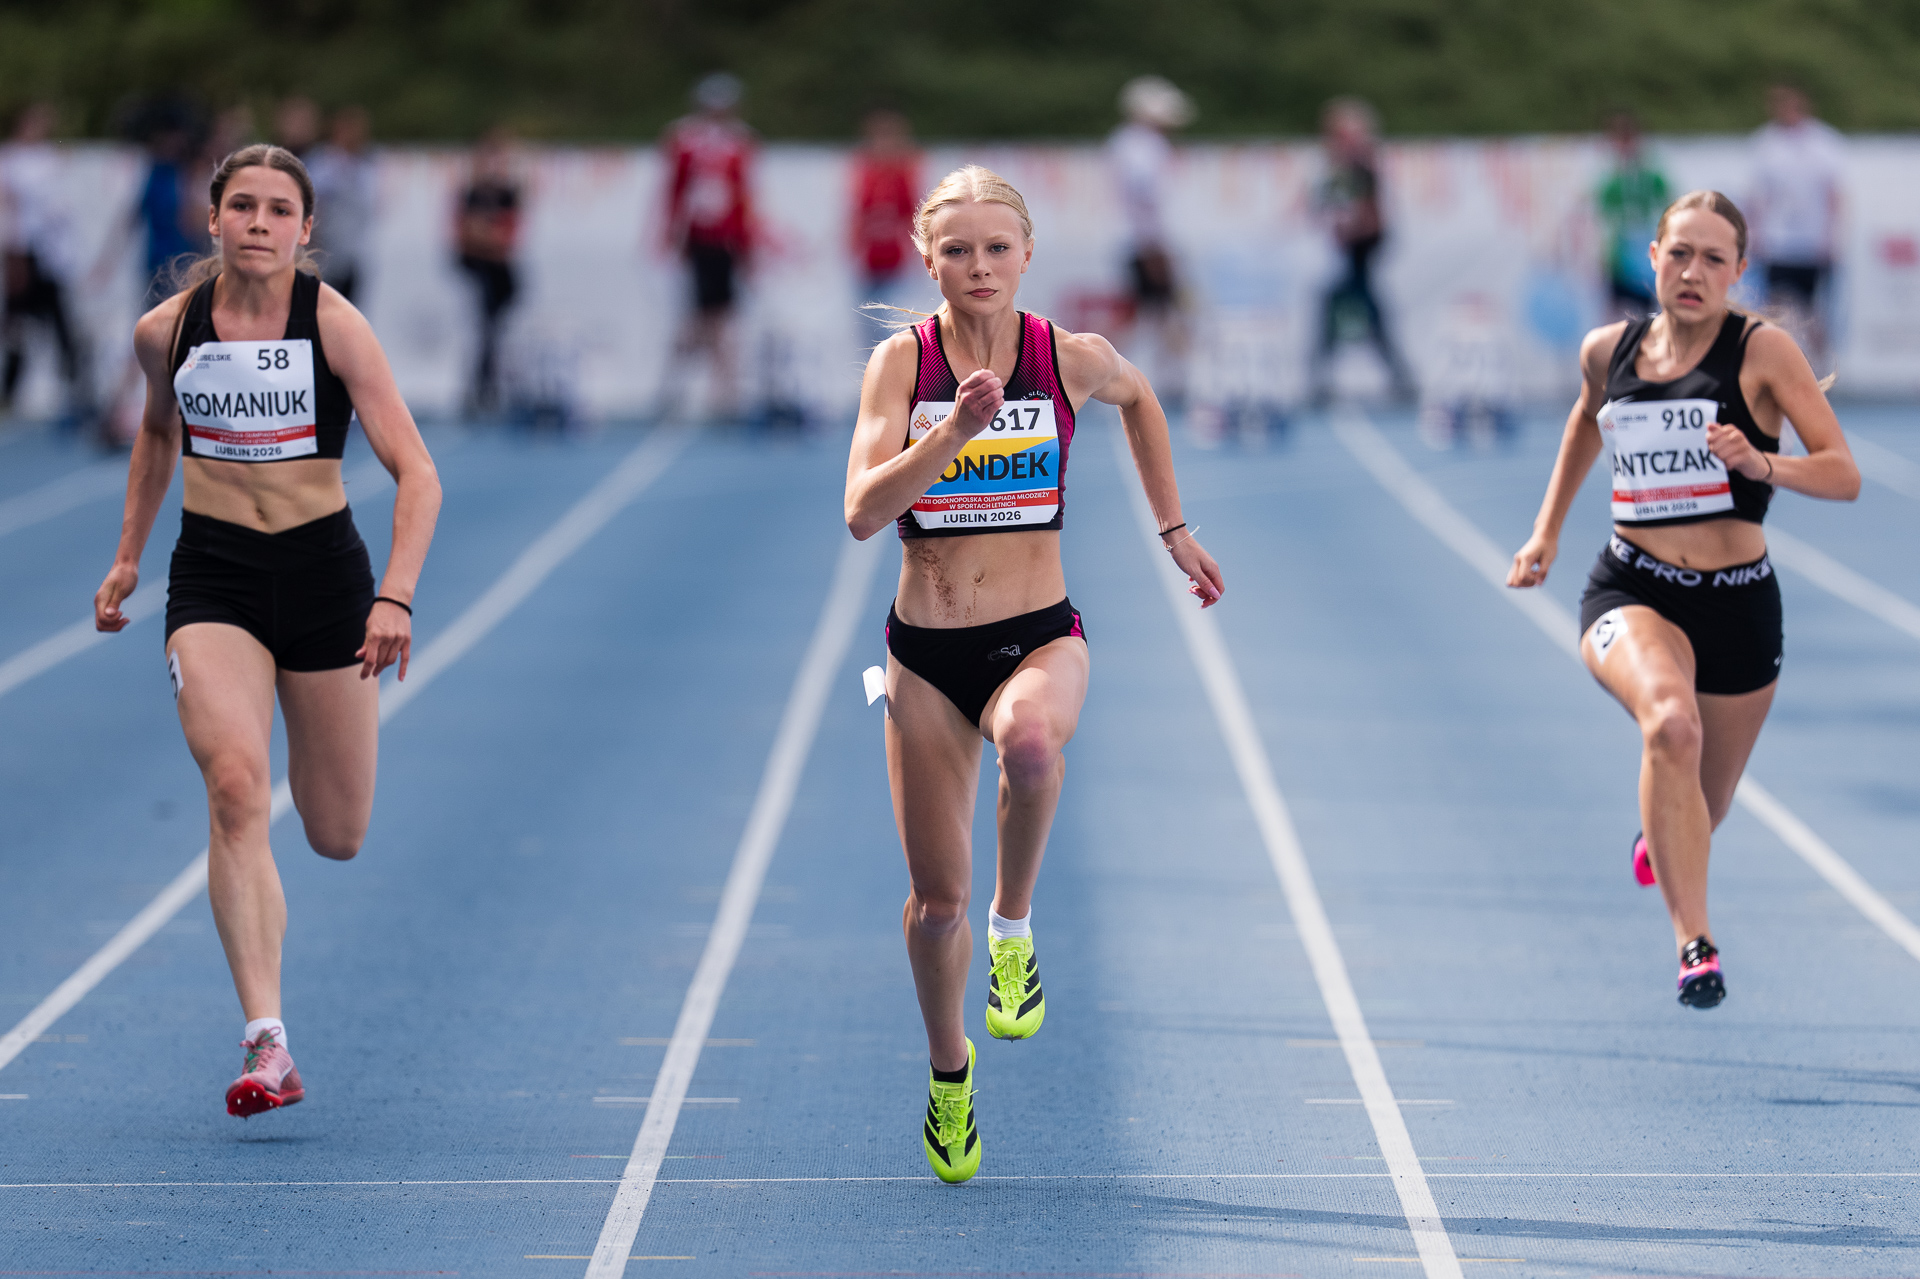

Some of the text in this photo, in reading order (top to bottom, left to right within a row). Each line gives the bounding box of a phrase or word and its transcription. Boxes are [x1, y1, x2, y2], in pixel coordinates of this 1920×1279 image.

[257, 348, 290, 371] 58
[181, 389, 308, 418] ROMANIUK
[989, 407, 1041, 432] 617
[1662, 407, 1704, 432] 910
[214, 445, 282, 457] LUBLIN 2026
[1612, 448, 1718, 478] ANTCZAK
[939, 451, 1050, 484] ONDEK
[957, 502, 991, 510] SPORTACH
[991, 500, 1017, 509] LETNICH
[983, 493, 1016, 503] OLIMPIADA
[943, 510, 1022, 524] LUBLIN 2026
[1634, 553, 1703, 588] PRO
